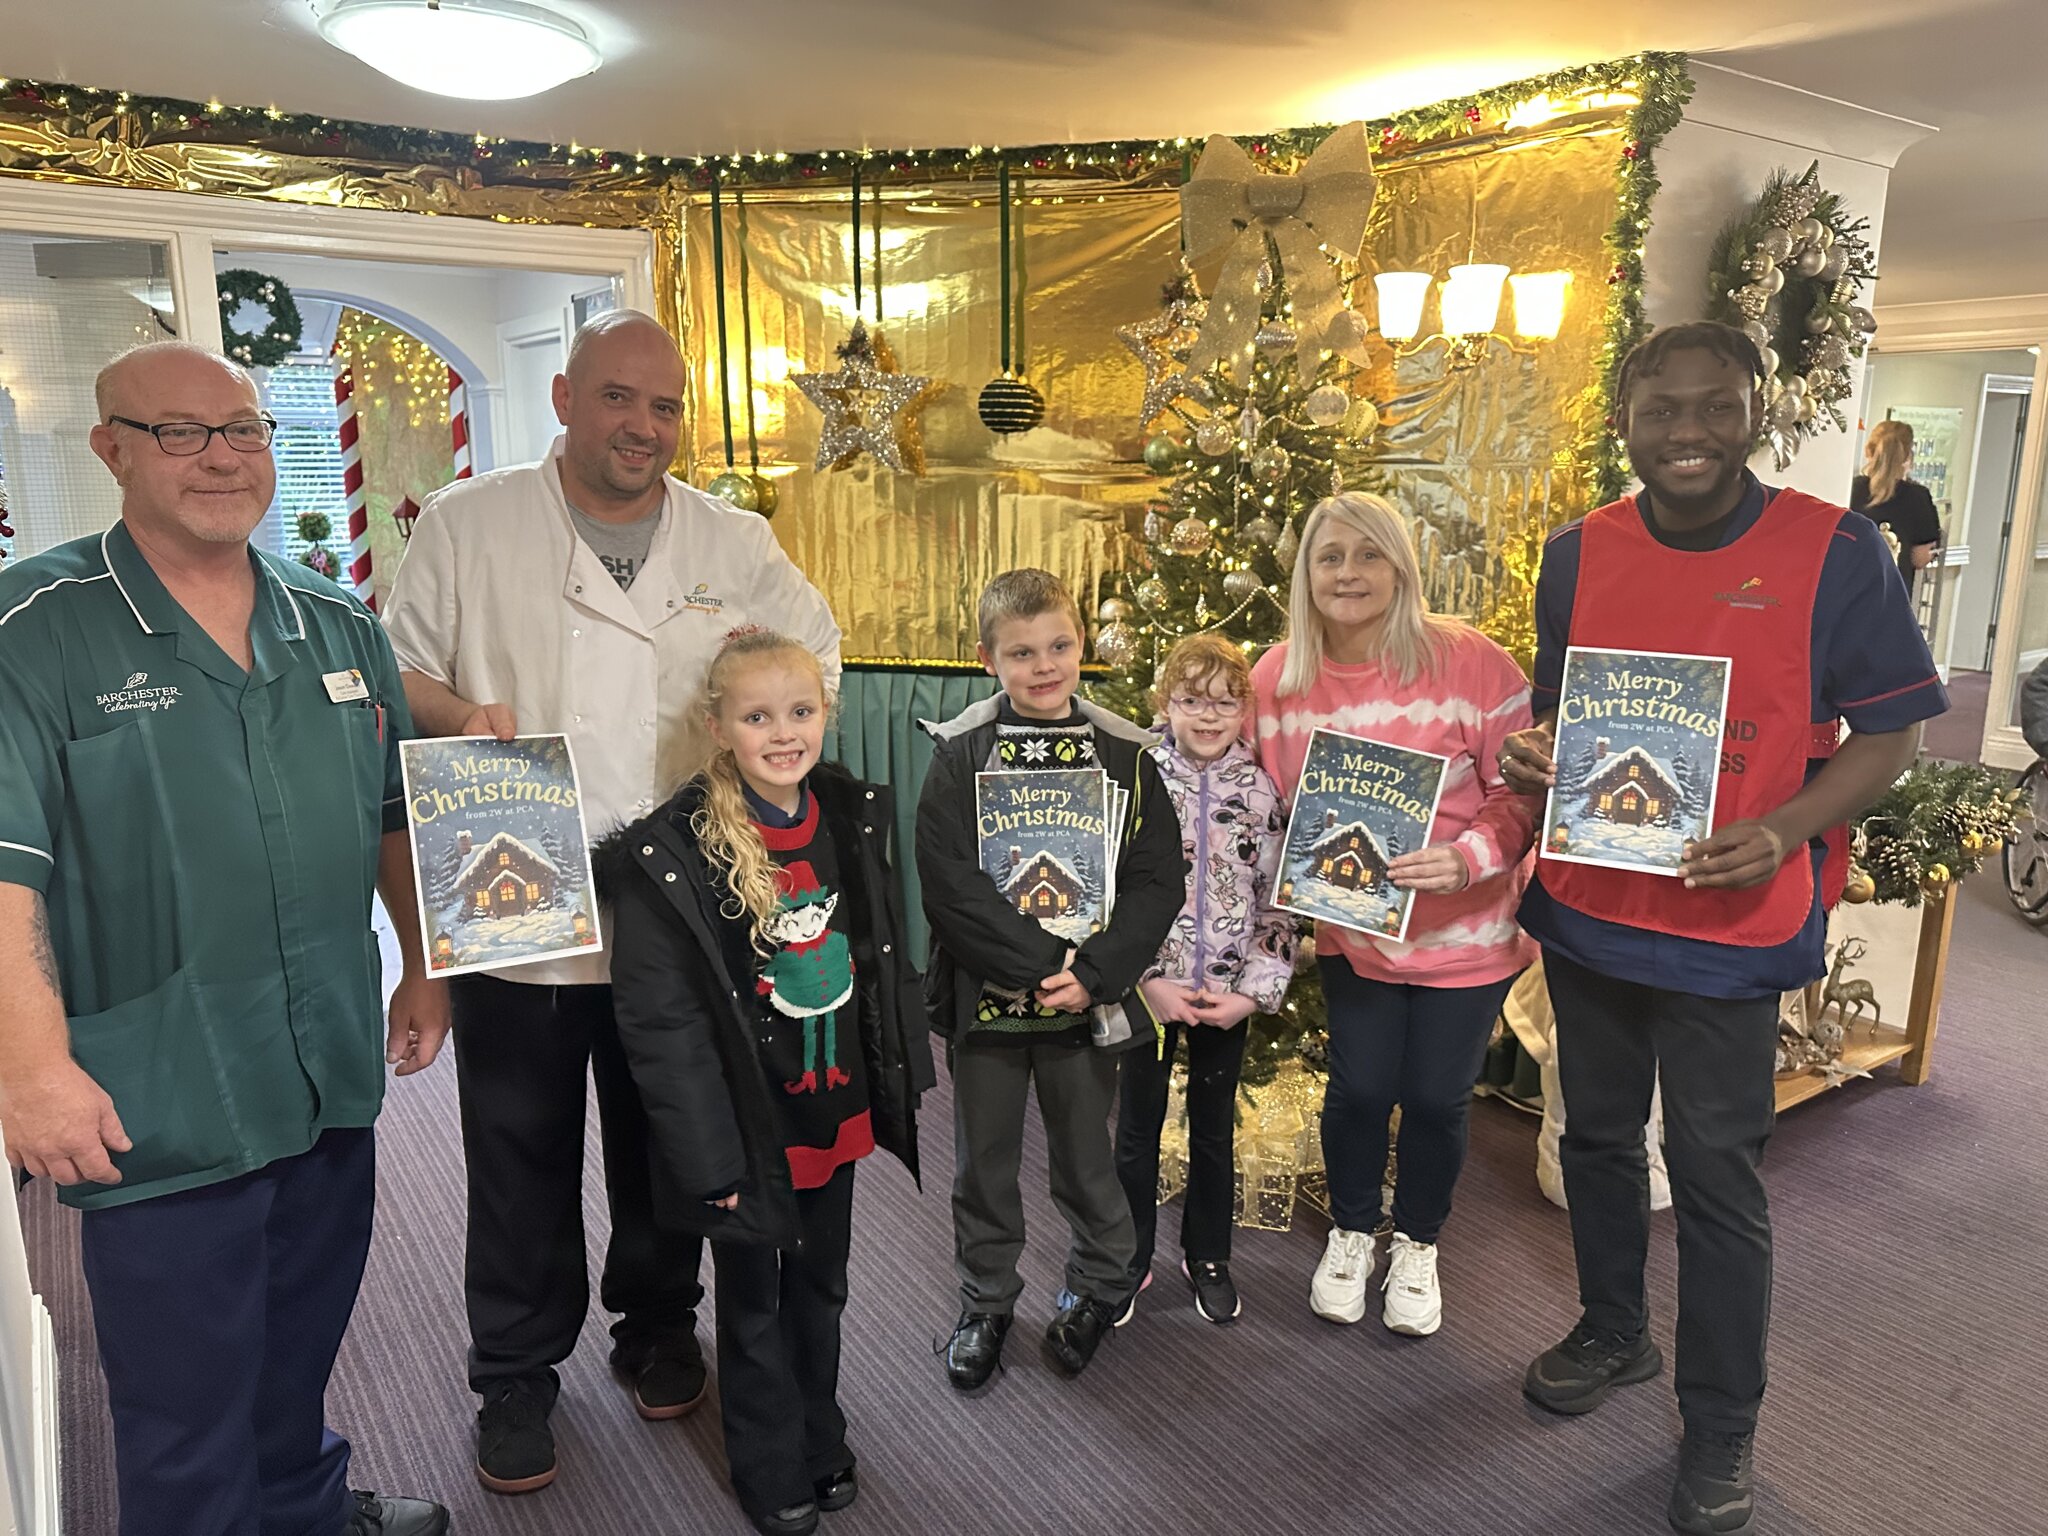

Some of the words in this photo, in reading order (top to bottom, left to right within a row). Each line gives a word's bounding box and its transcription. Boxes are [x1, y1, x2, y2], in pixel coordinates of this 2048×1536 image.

[598, 555, 633, 575] SH
[684, 595, 724, 608] RCHESTER
[95, 686, 183, 705] BARCHESTER
[1606, 670, 1683, 700] Merry
[104, 700, 159, 713] Celebrating
[159, 695, 177, 710] life
[1561, 690, 1720, 738] Christmas
[1608, 720, 1629, 730] from
[1630, 722, 1645, 731] 2W
[1646, 724, 1655, 732] at
[1655, 725, 1674, 734] PCA
[1723, 719, 1758, 741] ND
[451, 755, 531, 781] Merry
[1341, 753, 1407, 785] Merry
[1719, 751, 1746, 775] SS
[411, 776, 578, 824] Christmas
[1010, 785, 1072, 808] Merry
[1301, 769, 1432, 824] Christmas
[1338, 796, 1356, 806] from
[1369, 804, 1377, 812] at
[1377, 806, 1392, 815] PCA
[465, 810, 487, 820] from
[489, 808, 503, 817] 2W
[505, 807, 514, 816] at
[516, 806, 535, 815] PCA
[979, 804, 1105, 837] Christmas
